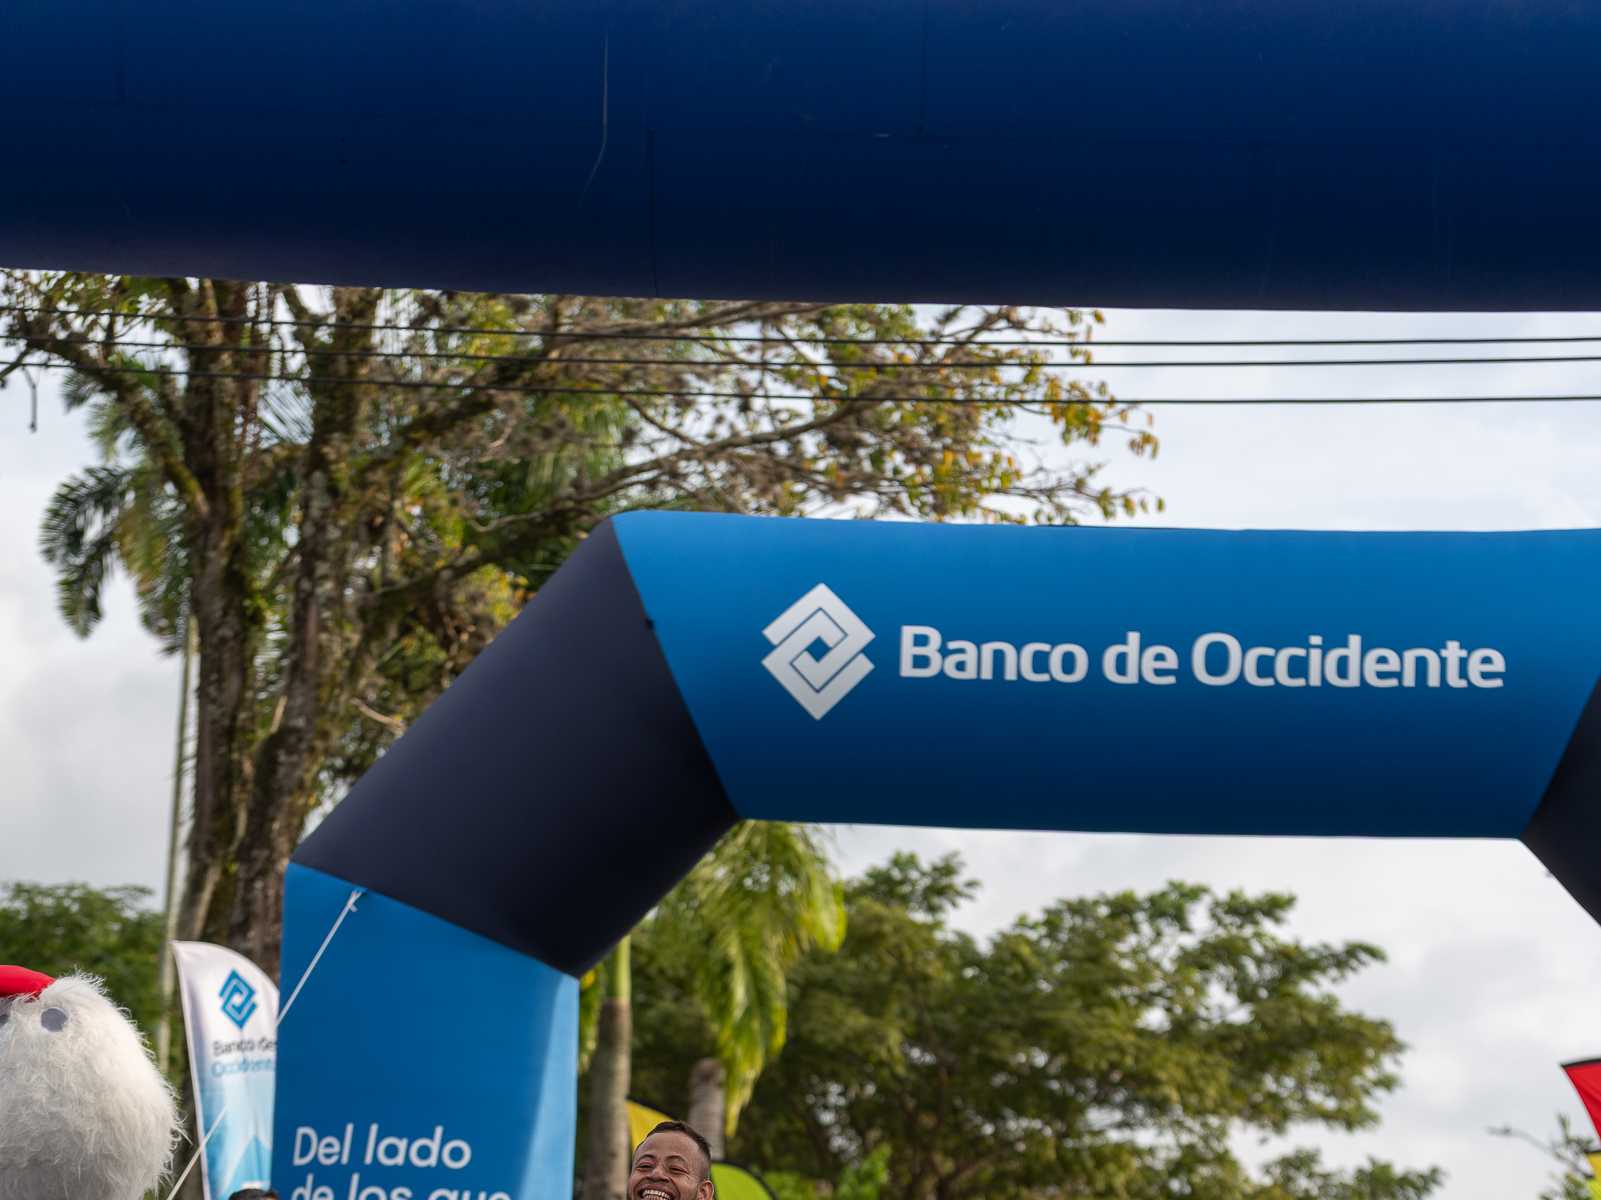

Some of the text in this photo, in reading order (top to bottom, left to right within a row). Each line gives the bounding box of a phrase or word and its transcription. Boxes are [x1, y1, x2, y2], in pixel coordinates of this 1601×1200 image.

[900, 625, 1507, 689] Banco de Occidente
[293, 1123, 472, 1169] Del lado
